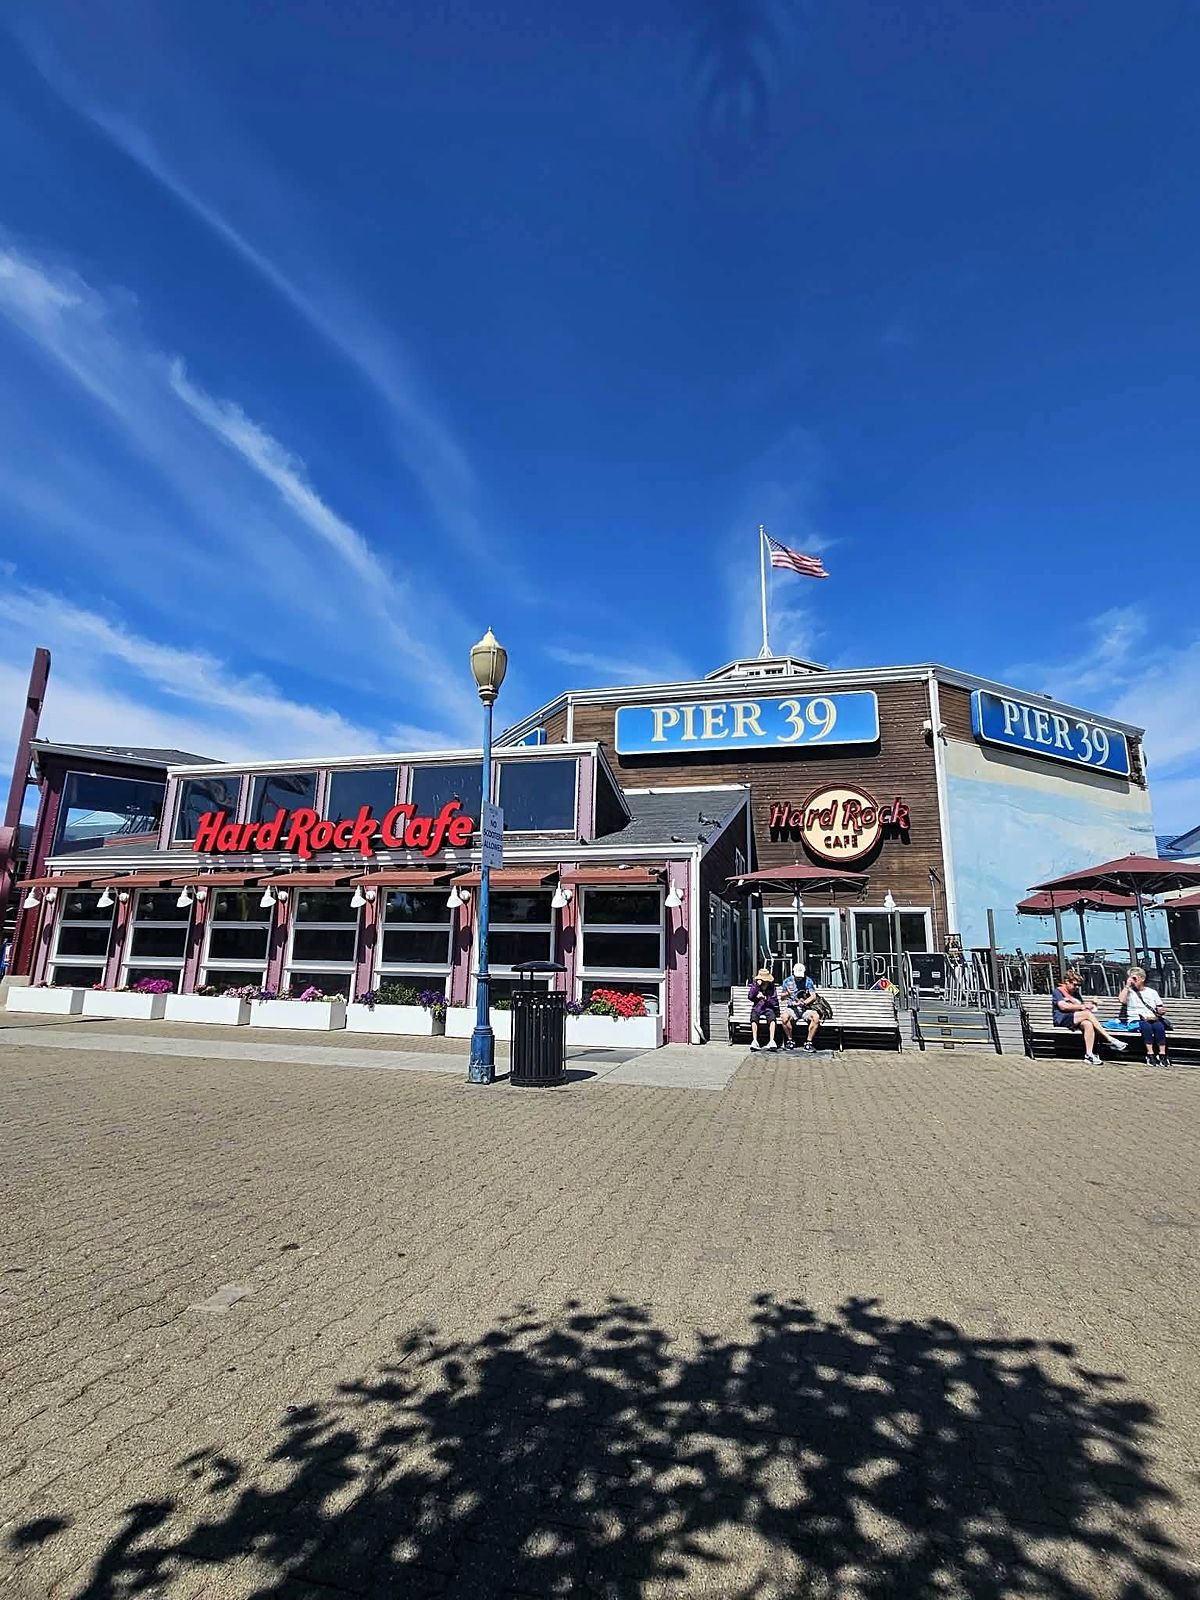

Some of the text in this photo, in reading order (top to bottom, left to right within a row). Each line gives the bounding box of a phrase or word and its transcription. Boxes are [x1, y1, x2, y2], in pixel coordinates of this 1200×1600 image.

[651, 698, 837, 743] PIER 39
[1001, 700, 1110, 766] PIER 39
[192, 800, 474, 860] Hard Rock Cafe
[490, 820, 498, 829] NO
[769, 797, 910, 832] Hard Rock
[483, 840, 503, 852] ALLOWED
[823, 835, 859, 849] CAFE
